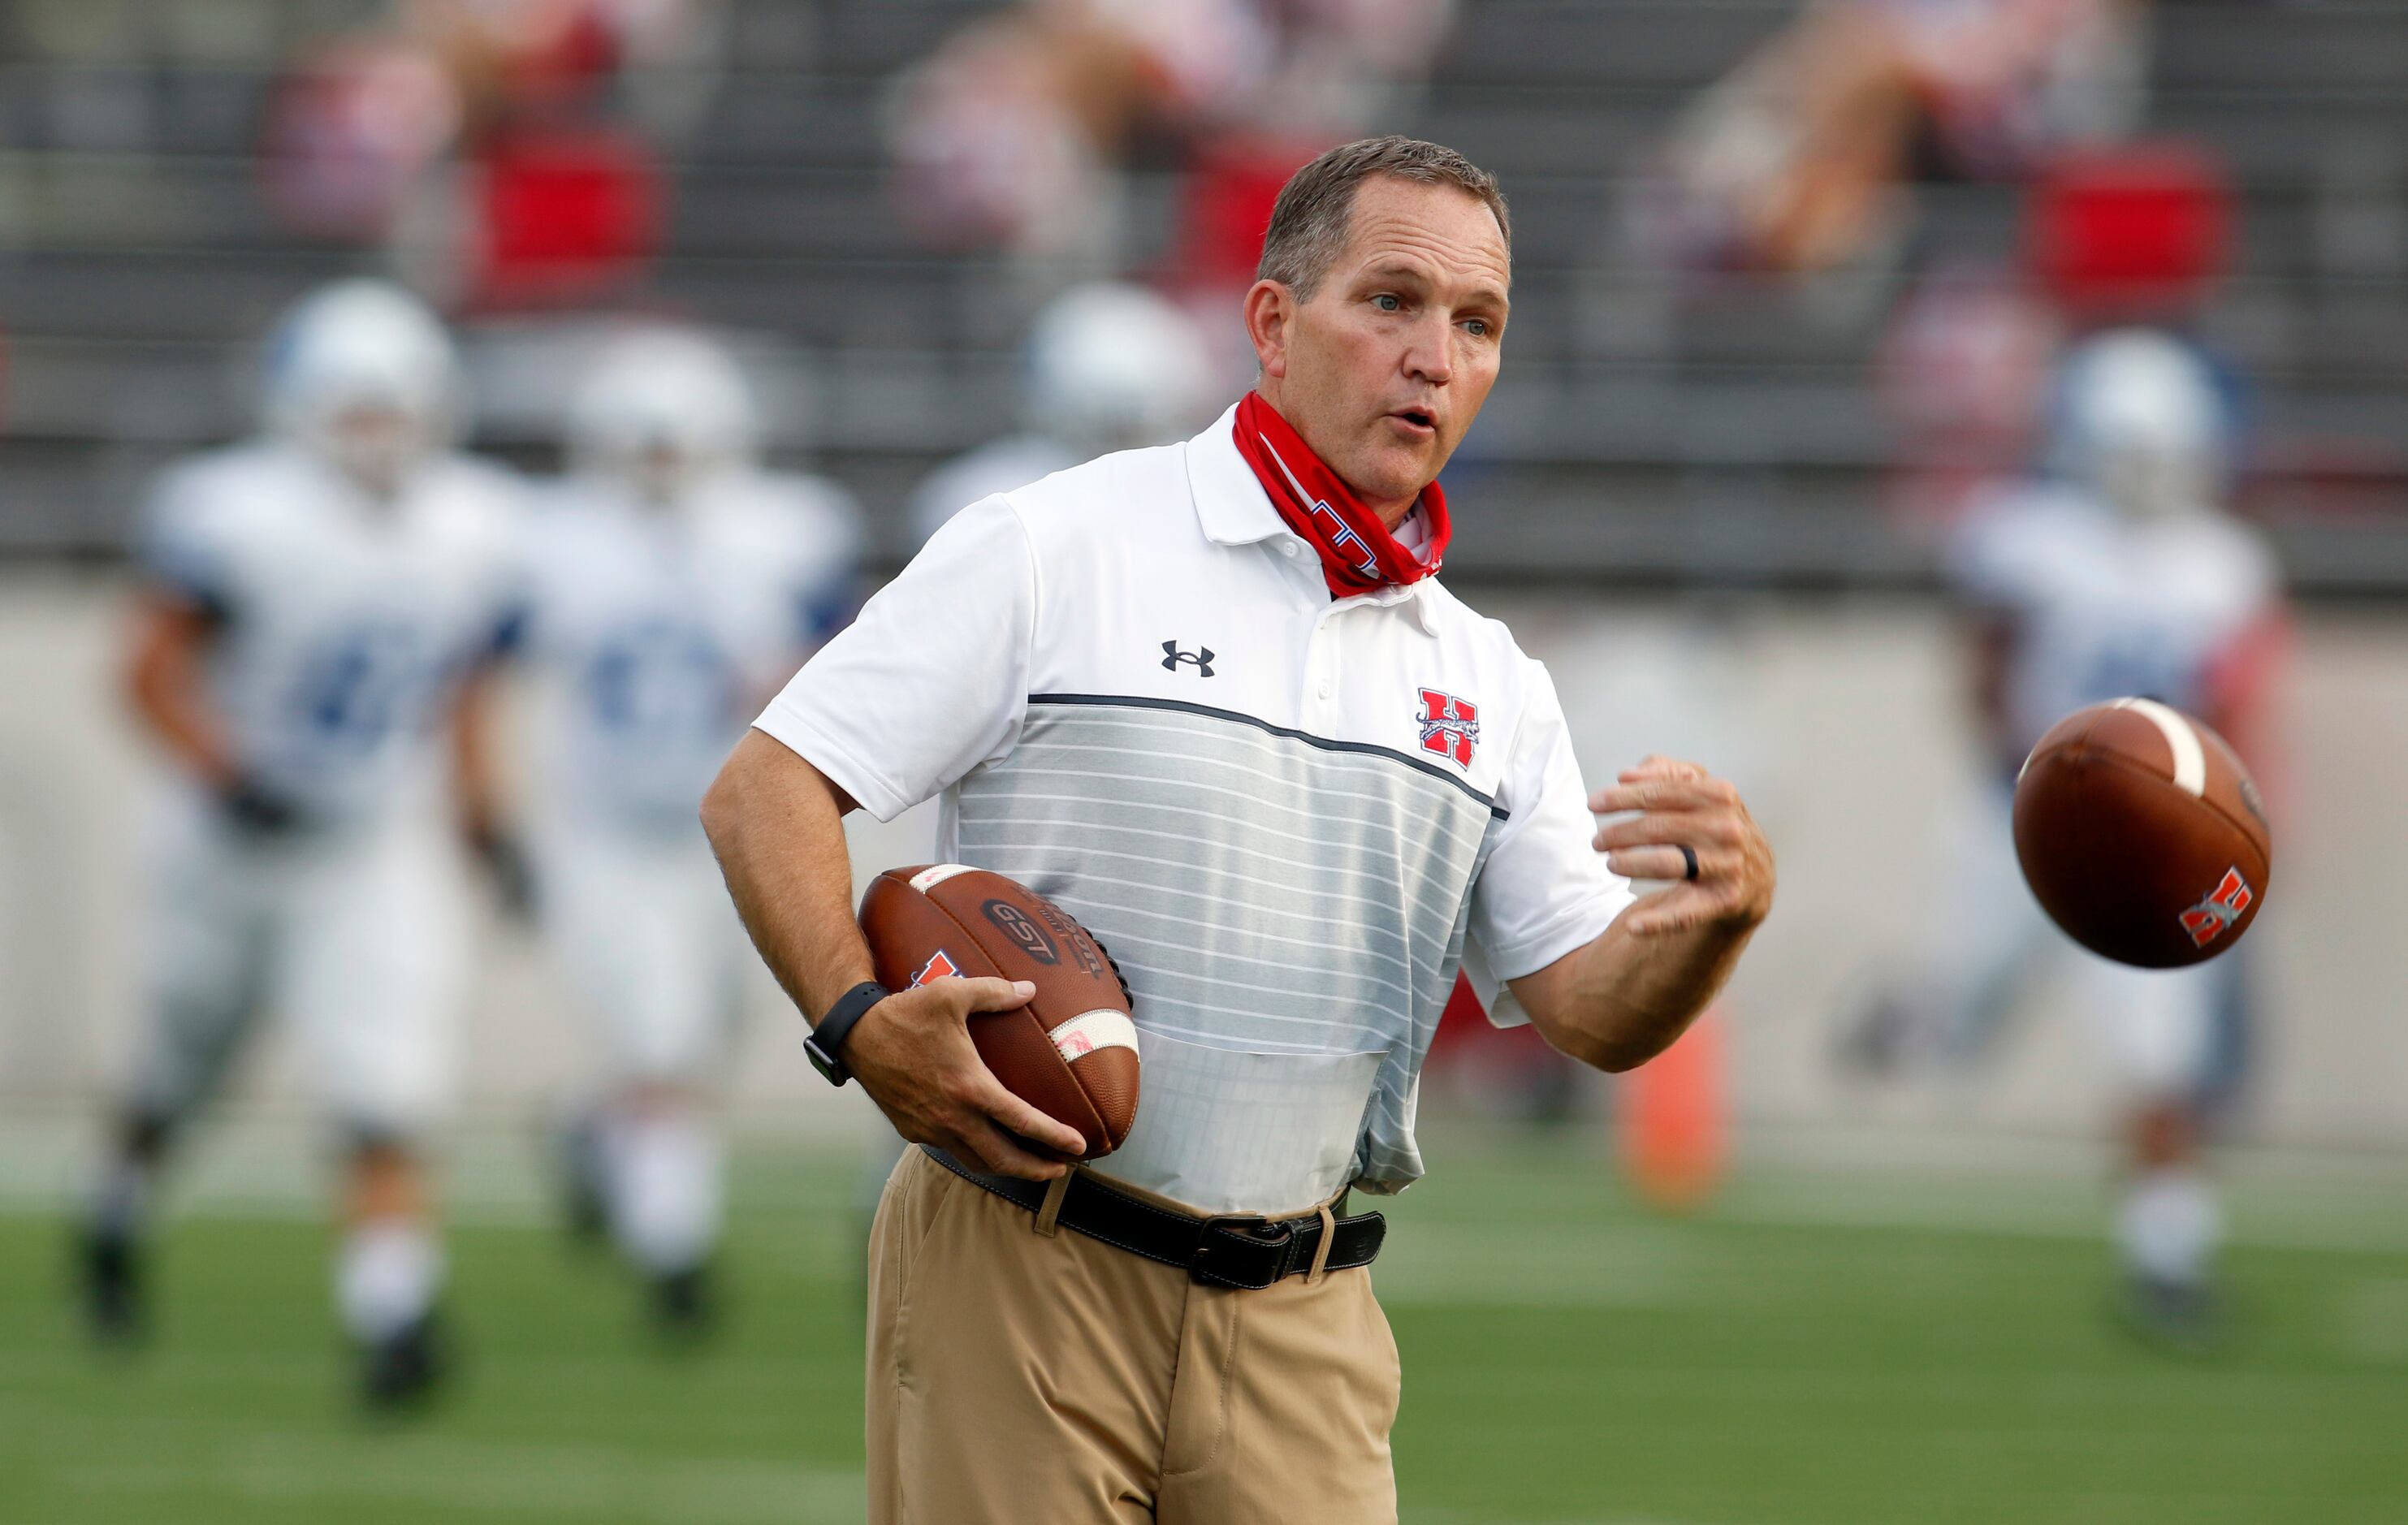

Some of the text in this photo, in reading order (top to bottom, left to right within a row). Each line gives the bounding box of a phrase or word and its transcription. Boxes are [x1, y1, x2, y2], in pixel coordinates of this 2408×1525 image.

[1417, 687, 1479, 772] H
[992, 903, 1055, 959] GST
[2179, 865, 2253, 948] H
